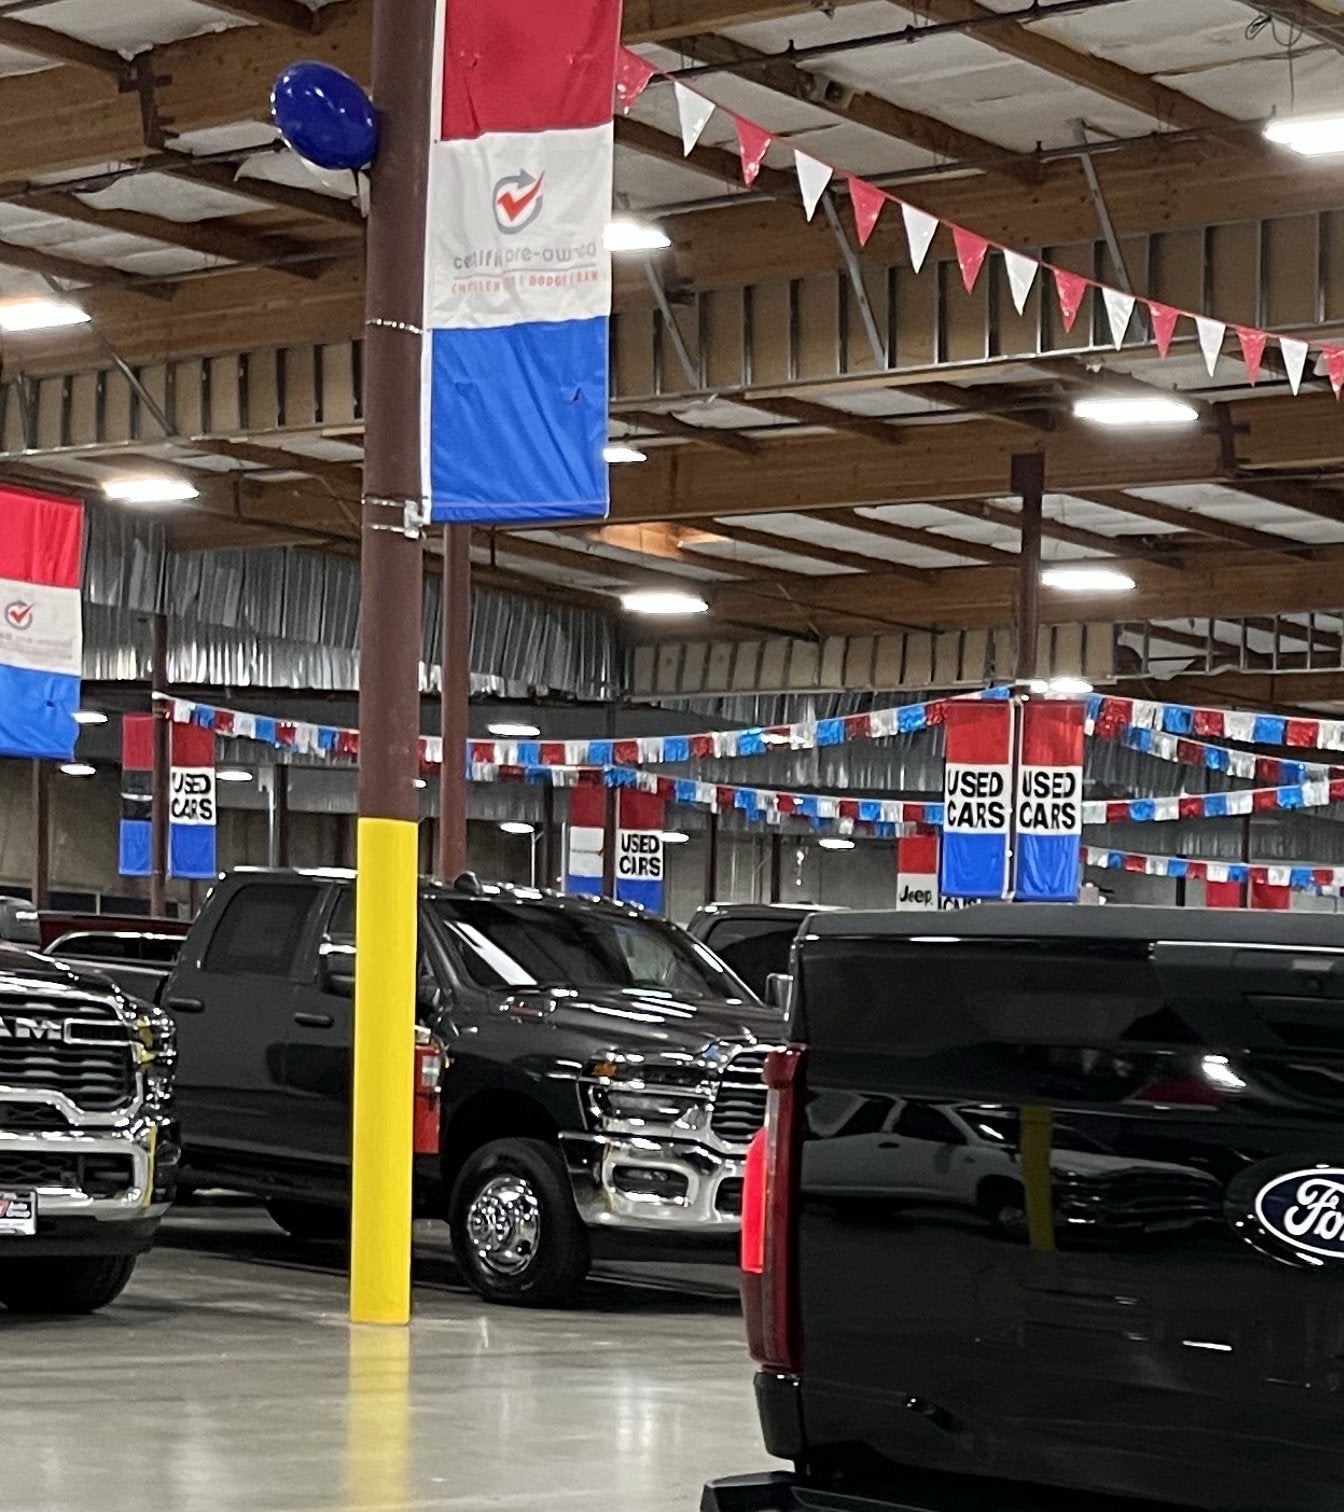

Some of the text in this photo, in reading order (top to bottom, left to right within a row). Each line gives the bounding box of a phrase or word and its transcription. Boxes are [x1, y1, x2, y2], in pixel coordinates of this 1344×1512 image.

[172, 773, 211, 794] USED
[948, 770, 1004, 798] USED
[1022, 771, 1076, 798] USED
[947, 801, 1005, 828] CARS
[1019, 802, 1076, 829] CARS
[621, 833, 660, 854] USED
[900, 885, 933, 906] Jeep
